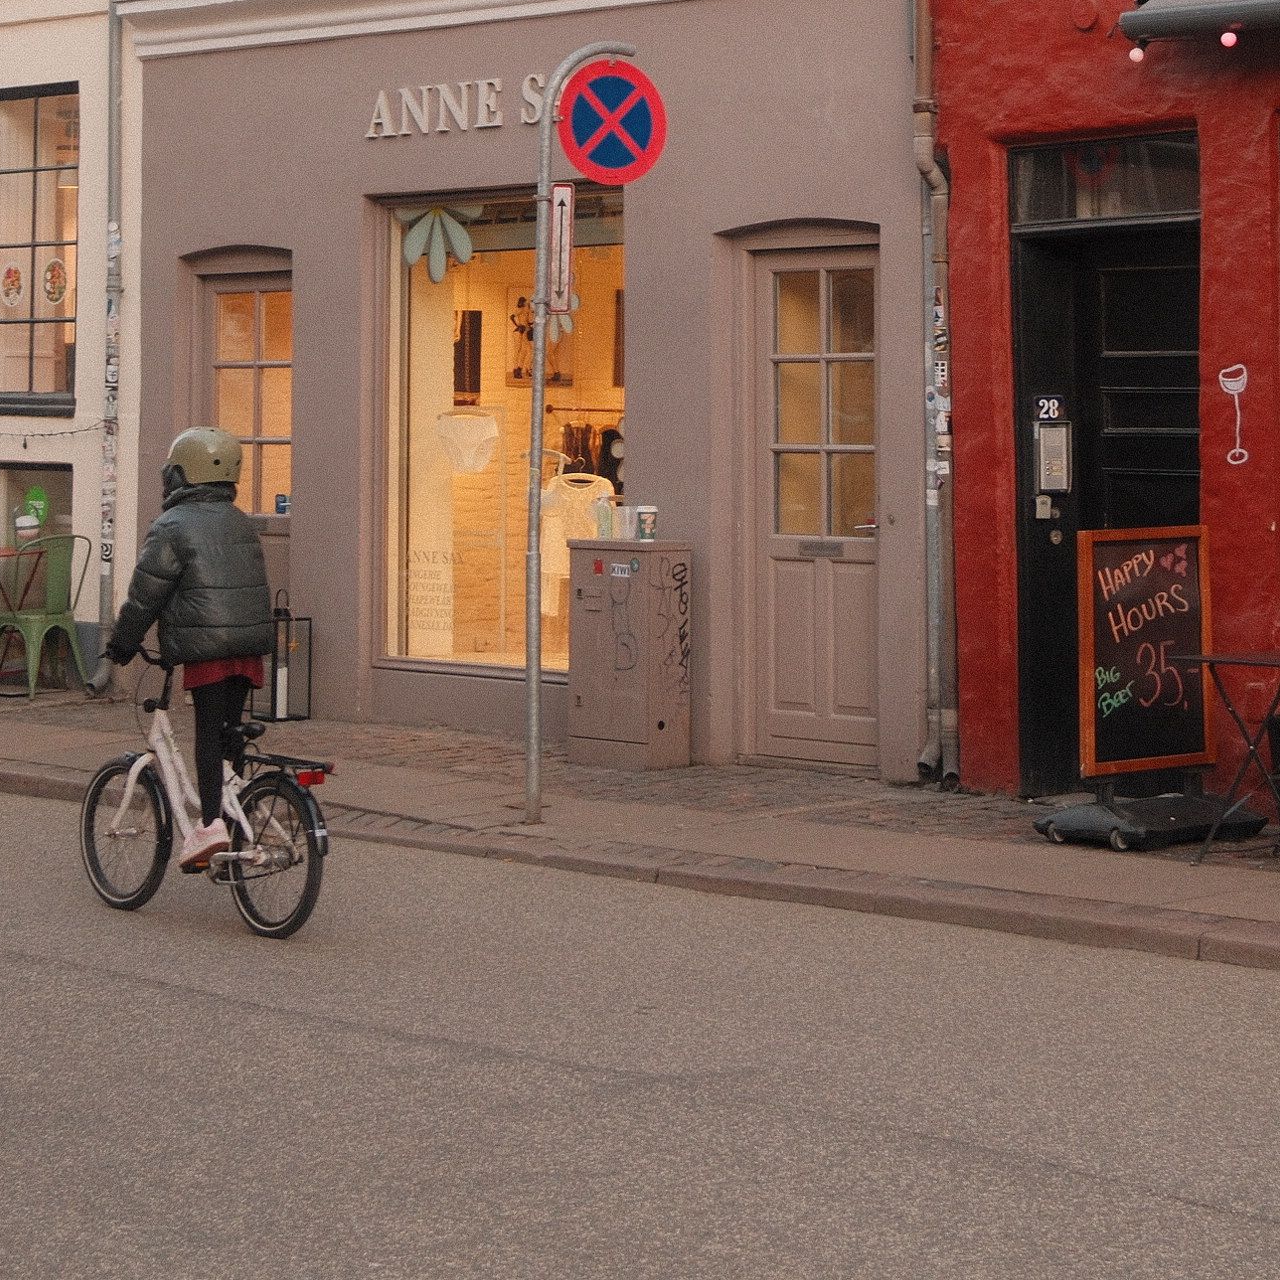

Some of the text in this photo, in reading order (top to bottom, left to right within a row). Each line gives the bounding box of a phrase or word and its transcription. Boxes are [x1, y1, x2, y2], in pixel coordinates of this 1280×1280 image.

[365, 78, 503, 138] ANNE
[1038, 398, 1060, 418] 28
[1098, 549, 1155, 602] HAPPY
[1107, 585, 1190, 644] HOURS
